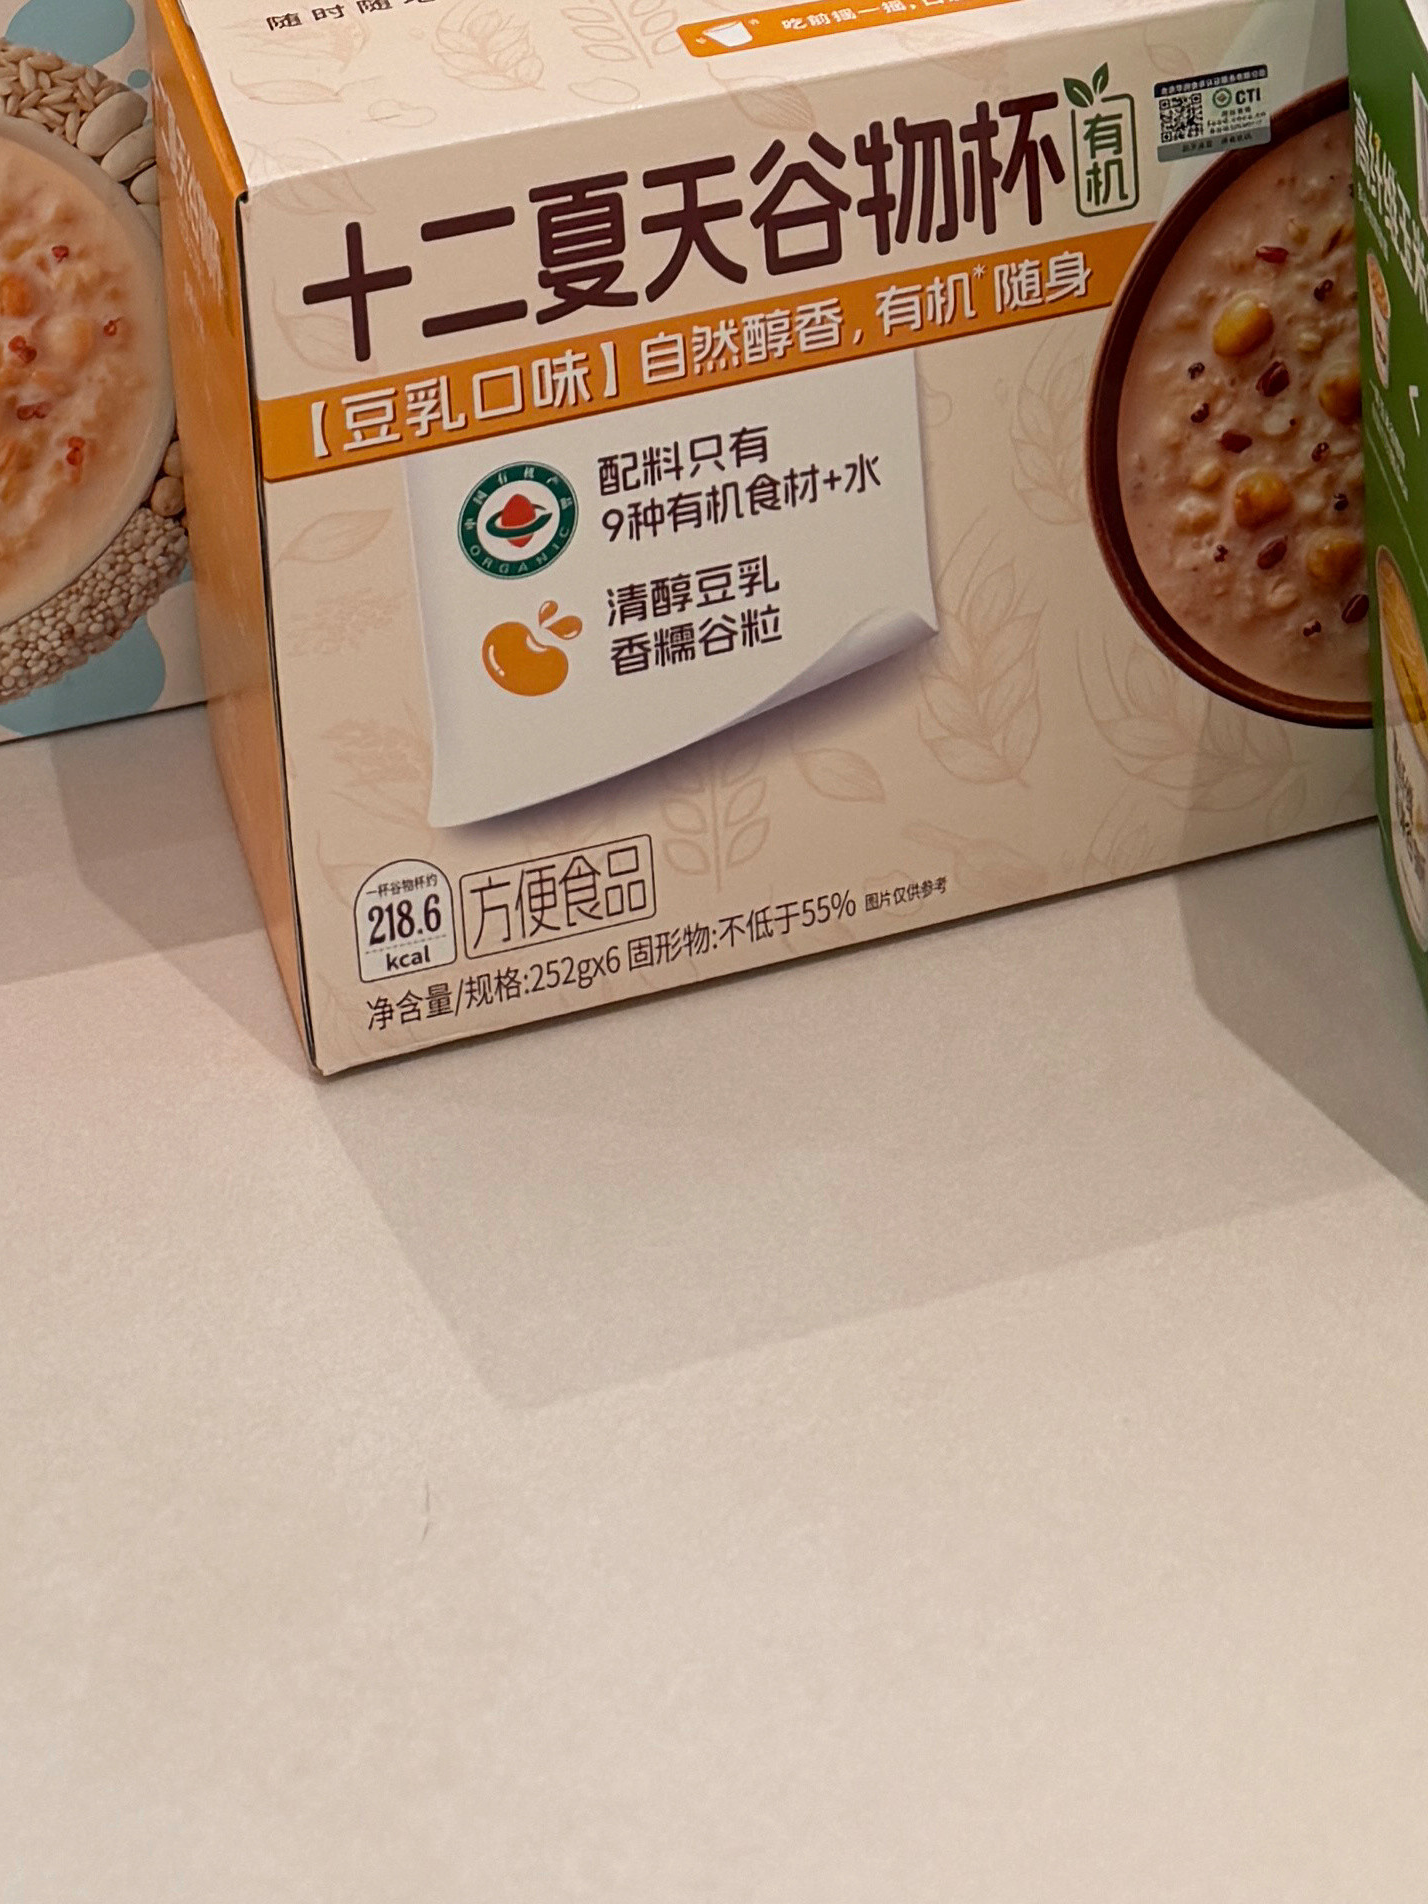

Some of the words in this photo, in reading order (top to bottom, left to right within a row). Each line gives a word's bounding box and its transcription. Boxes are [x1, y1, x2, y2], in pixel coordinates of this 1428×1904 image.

[1236, 88, 1261, 104] CTI
[1083, 113, 1129, 206] 有机
[302, 92, 1065, 361] 十二夏天谷物杯
[597, 425, 769, 495] 配料只有
[602, 453, 882, 542] 9种有机食材+水
[470, 526, 570, 573] ORGANIC
[606, 555, 780, 627] 清醇豆乳
[610, 606, 782, 678] 香糯谷粒
[367, 873, 439, 898] 一杯谷物杯约
[470, 845, 647, 949] 方便食品
[864, 874, 947, 914] 图片仅供参考
[367, 894, 442, 949] 218.6
[385, 946, 431, 972] kcal
